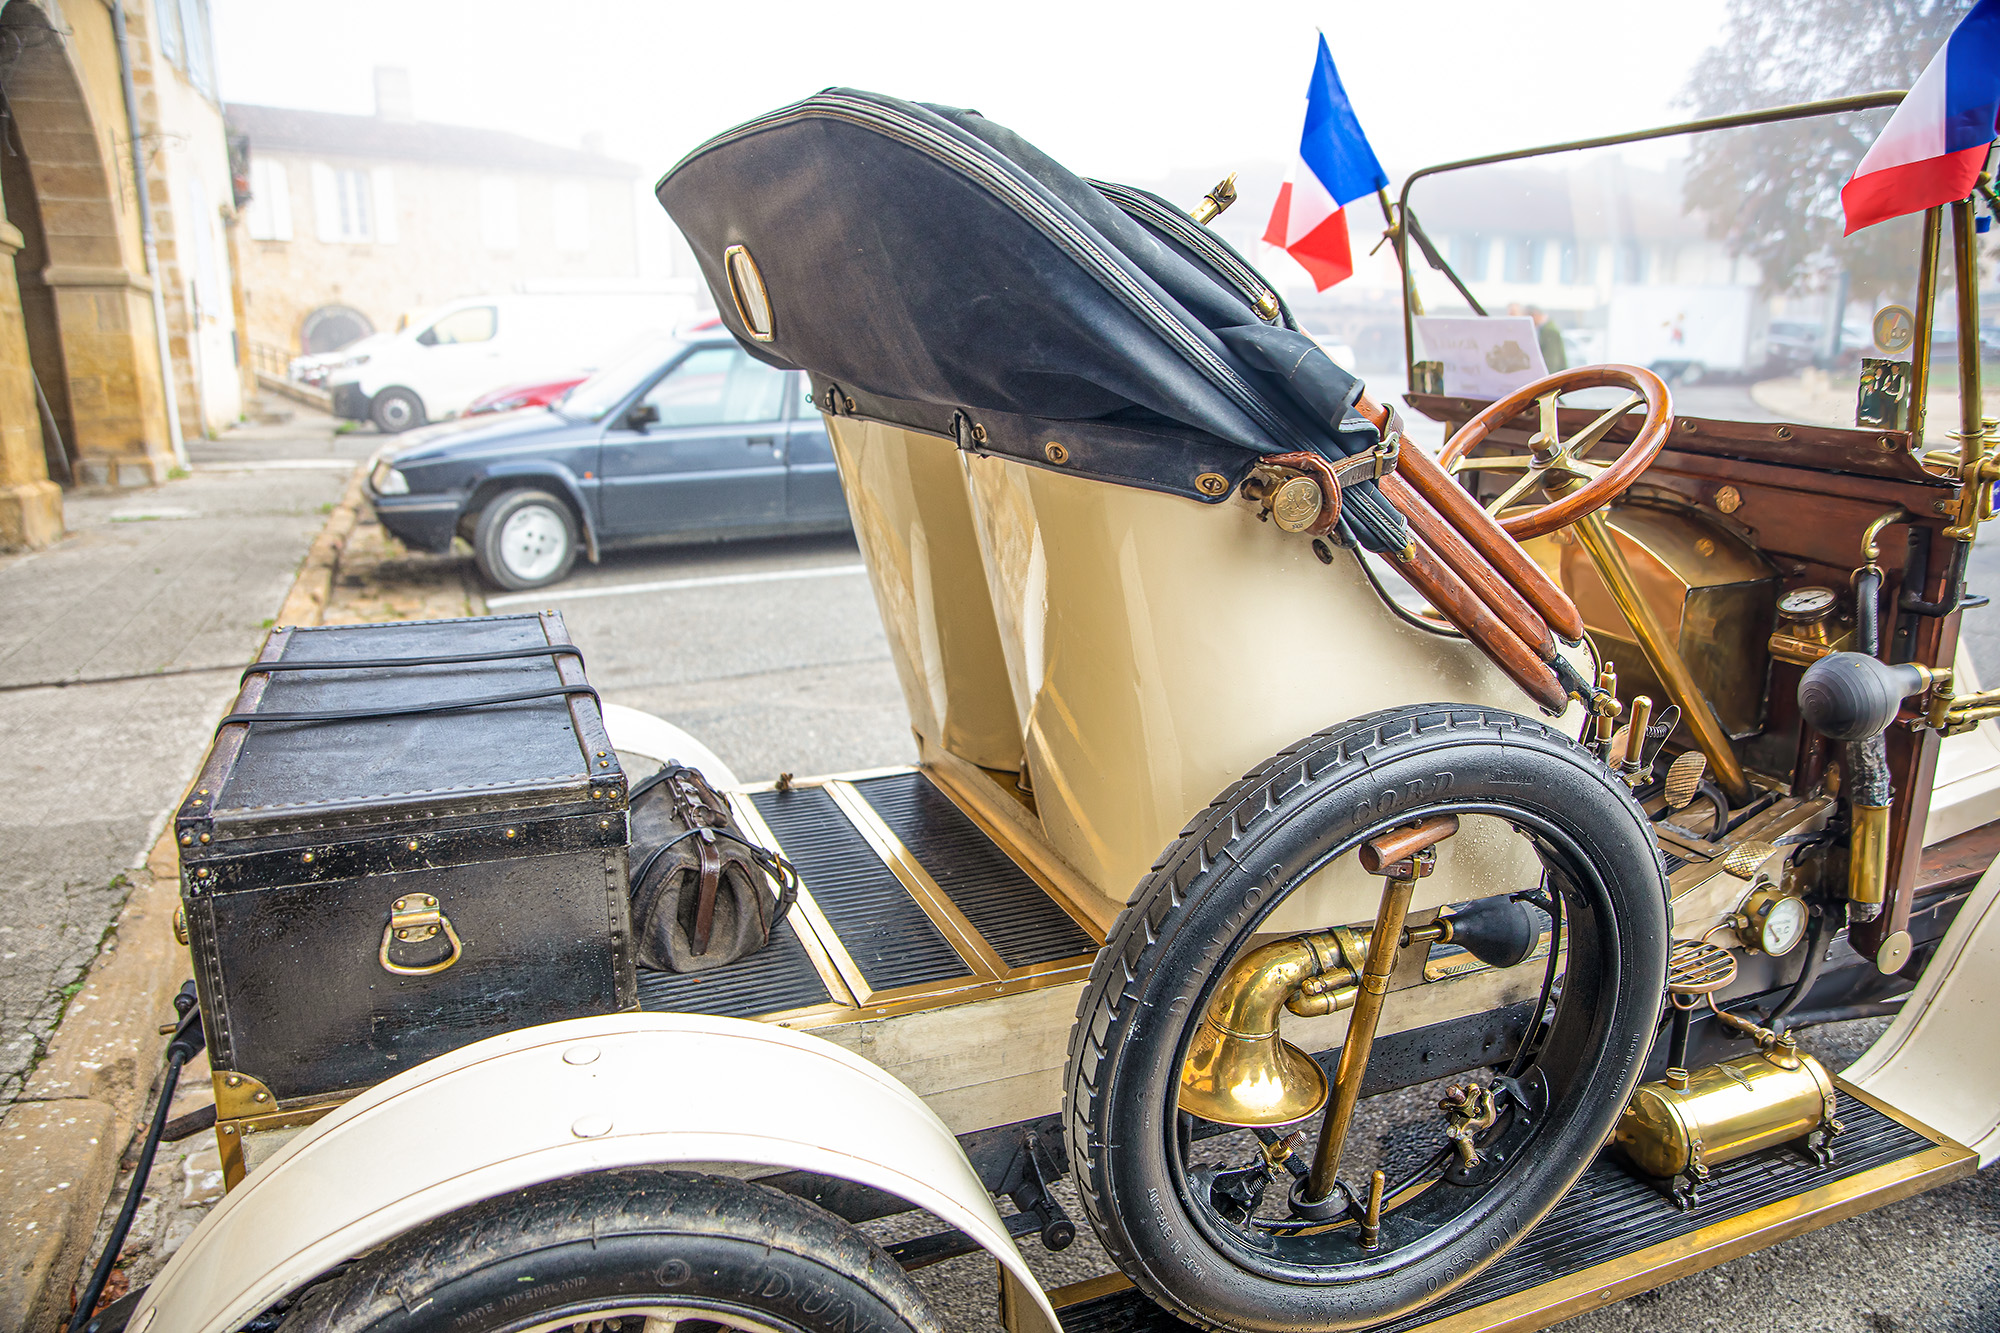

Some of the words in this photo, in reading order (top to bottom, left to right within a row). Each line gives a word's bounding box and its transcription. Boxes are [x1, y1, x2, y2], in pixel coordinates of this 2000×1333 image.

[1352, 771, 1455, 826] CORD
[1167, 862, 1284, 1018] DUNLOP
[456, 1302, 496, 1328] MADE
[503, 1294, 518, 1308] IN
[523, 1276, 588, 1301] ENGLAND
